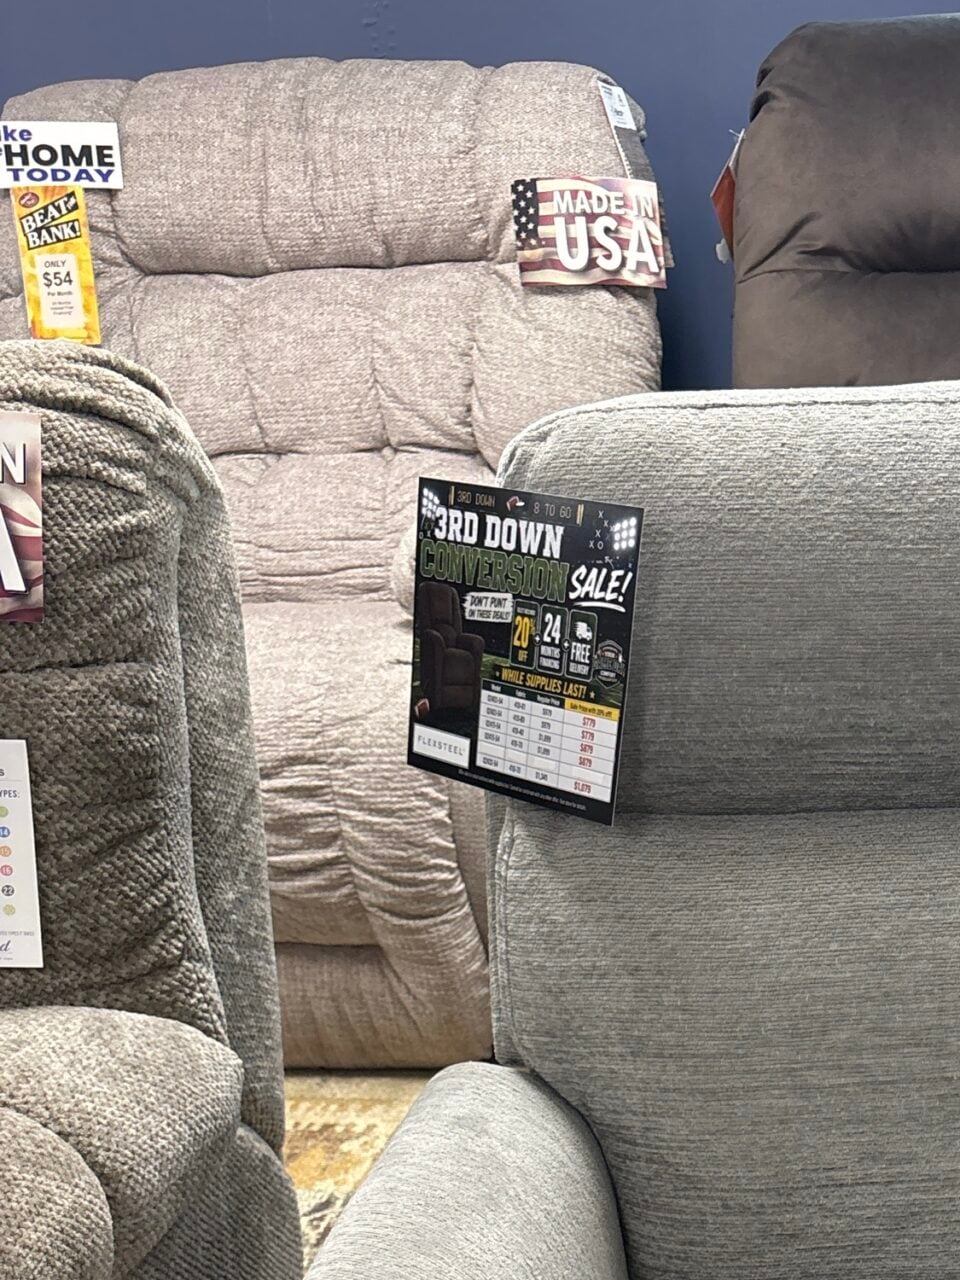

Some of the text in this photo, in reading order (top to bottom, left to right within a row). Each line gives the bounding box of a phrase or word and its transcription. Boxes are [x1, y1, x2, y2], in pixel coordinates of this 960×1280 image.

[0, 125, 32, 141] ke
[4, 144, 115, 167] HOME
[6, 168, 115, 182] TODAY
[552, 191, 656, 218] MADE IN
[21, 198, 67, 234] BEAT
[27, 220, 80, 249] BANK!
[554, 216, 660, 273] USA
[44, 260, 67, 268] ONLY
[43, 271, 73, 288] $54
[457, 489, 572, 519] 3RD DOWN 8 TO GO
[435, 507, 565, 559] 3RD DOWN
[420, 538, 570, 603] CONVERSION
[569, 564, 633, 603] SALE!
[470, 595, 508, 608] DON'T PUNT
[468, 608, 476, 617] ON
[476, 609, 492, 618] THESE
[492, 610, 511, 620] DEALS!
[543, 612, 562, 645] 24
[518, 649, 528, 662] OFF
[540, 645, 560, 658] MONTHS
[570, 642, 591, 663] FREE
[569, 662, 589, 675] DELIVERY
[500, 666, 588, 699] WHILE SUPPLIES LAST!
[582, 716, 596, 728] $779
[418, 735, 463, 756] FLEXSTEEL
[581, 730, 595, 741] $779
[4, 887, 13, 895] 22
